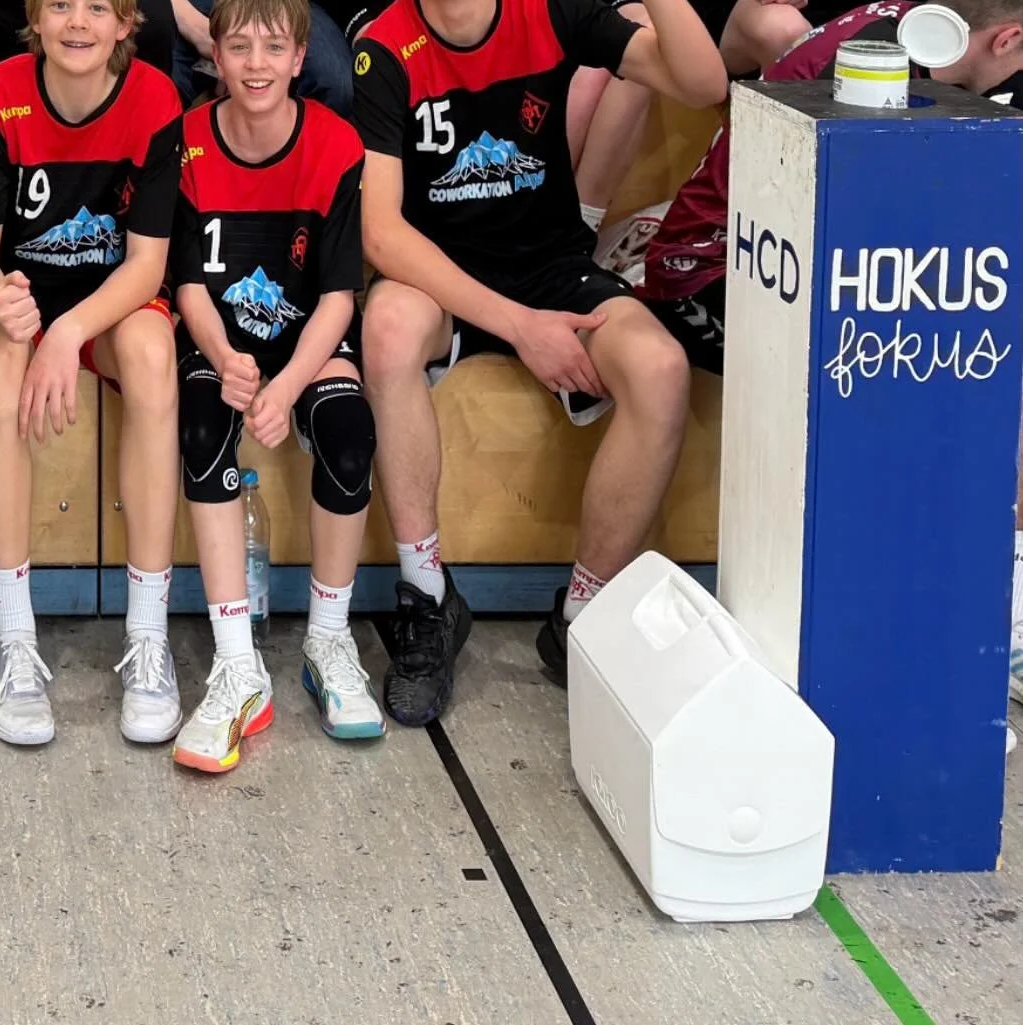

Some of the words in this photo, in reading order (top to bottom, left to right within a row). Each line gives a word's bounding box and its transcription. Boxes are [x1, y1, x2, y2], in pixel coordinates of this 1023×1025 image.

[415, 98, 456, 155] 15
[428, 180, 513, 203] COWORKATION
[202, 217, 227, 273] 1
[735, 211, 801, 305] HCD
[830, 245, 1010, 312] HOKUS
[823, 316, 1012, 398] fokus
[219, 604, 250, 618] Kemp
